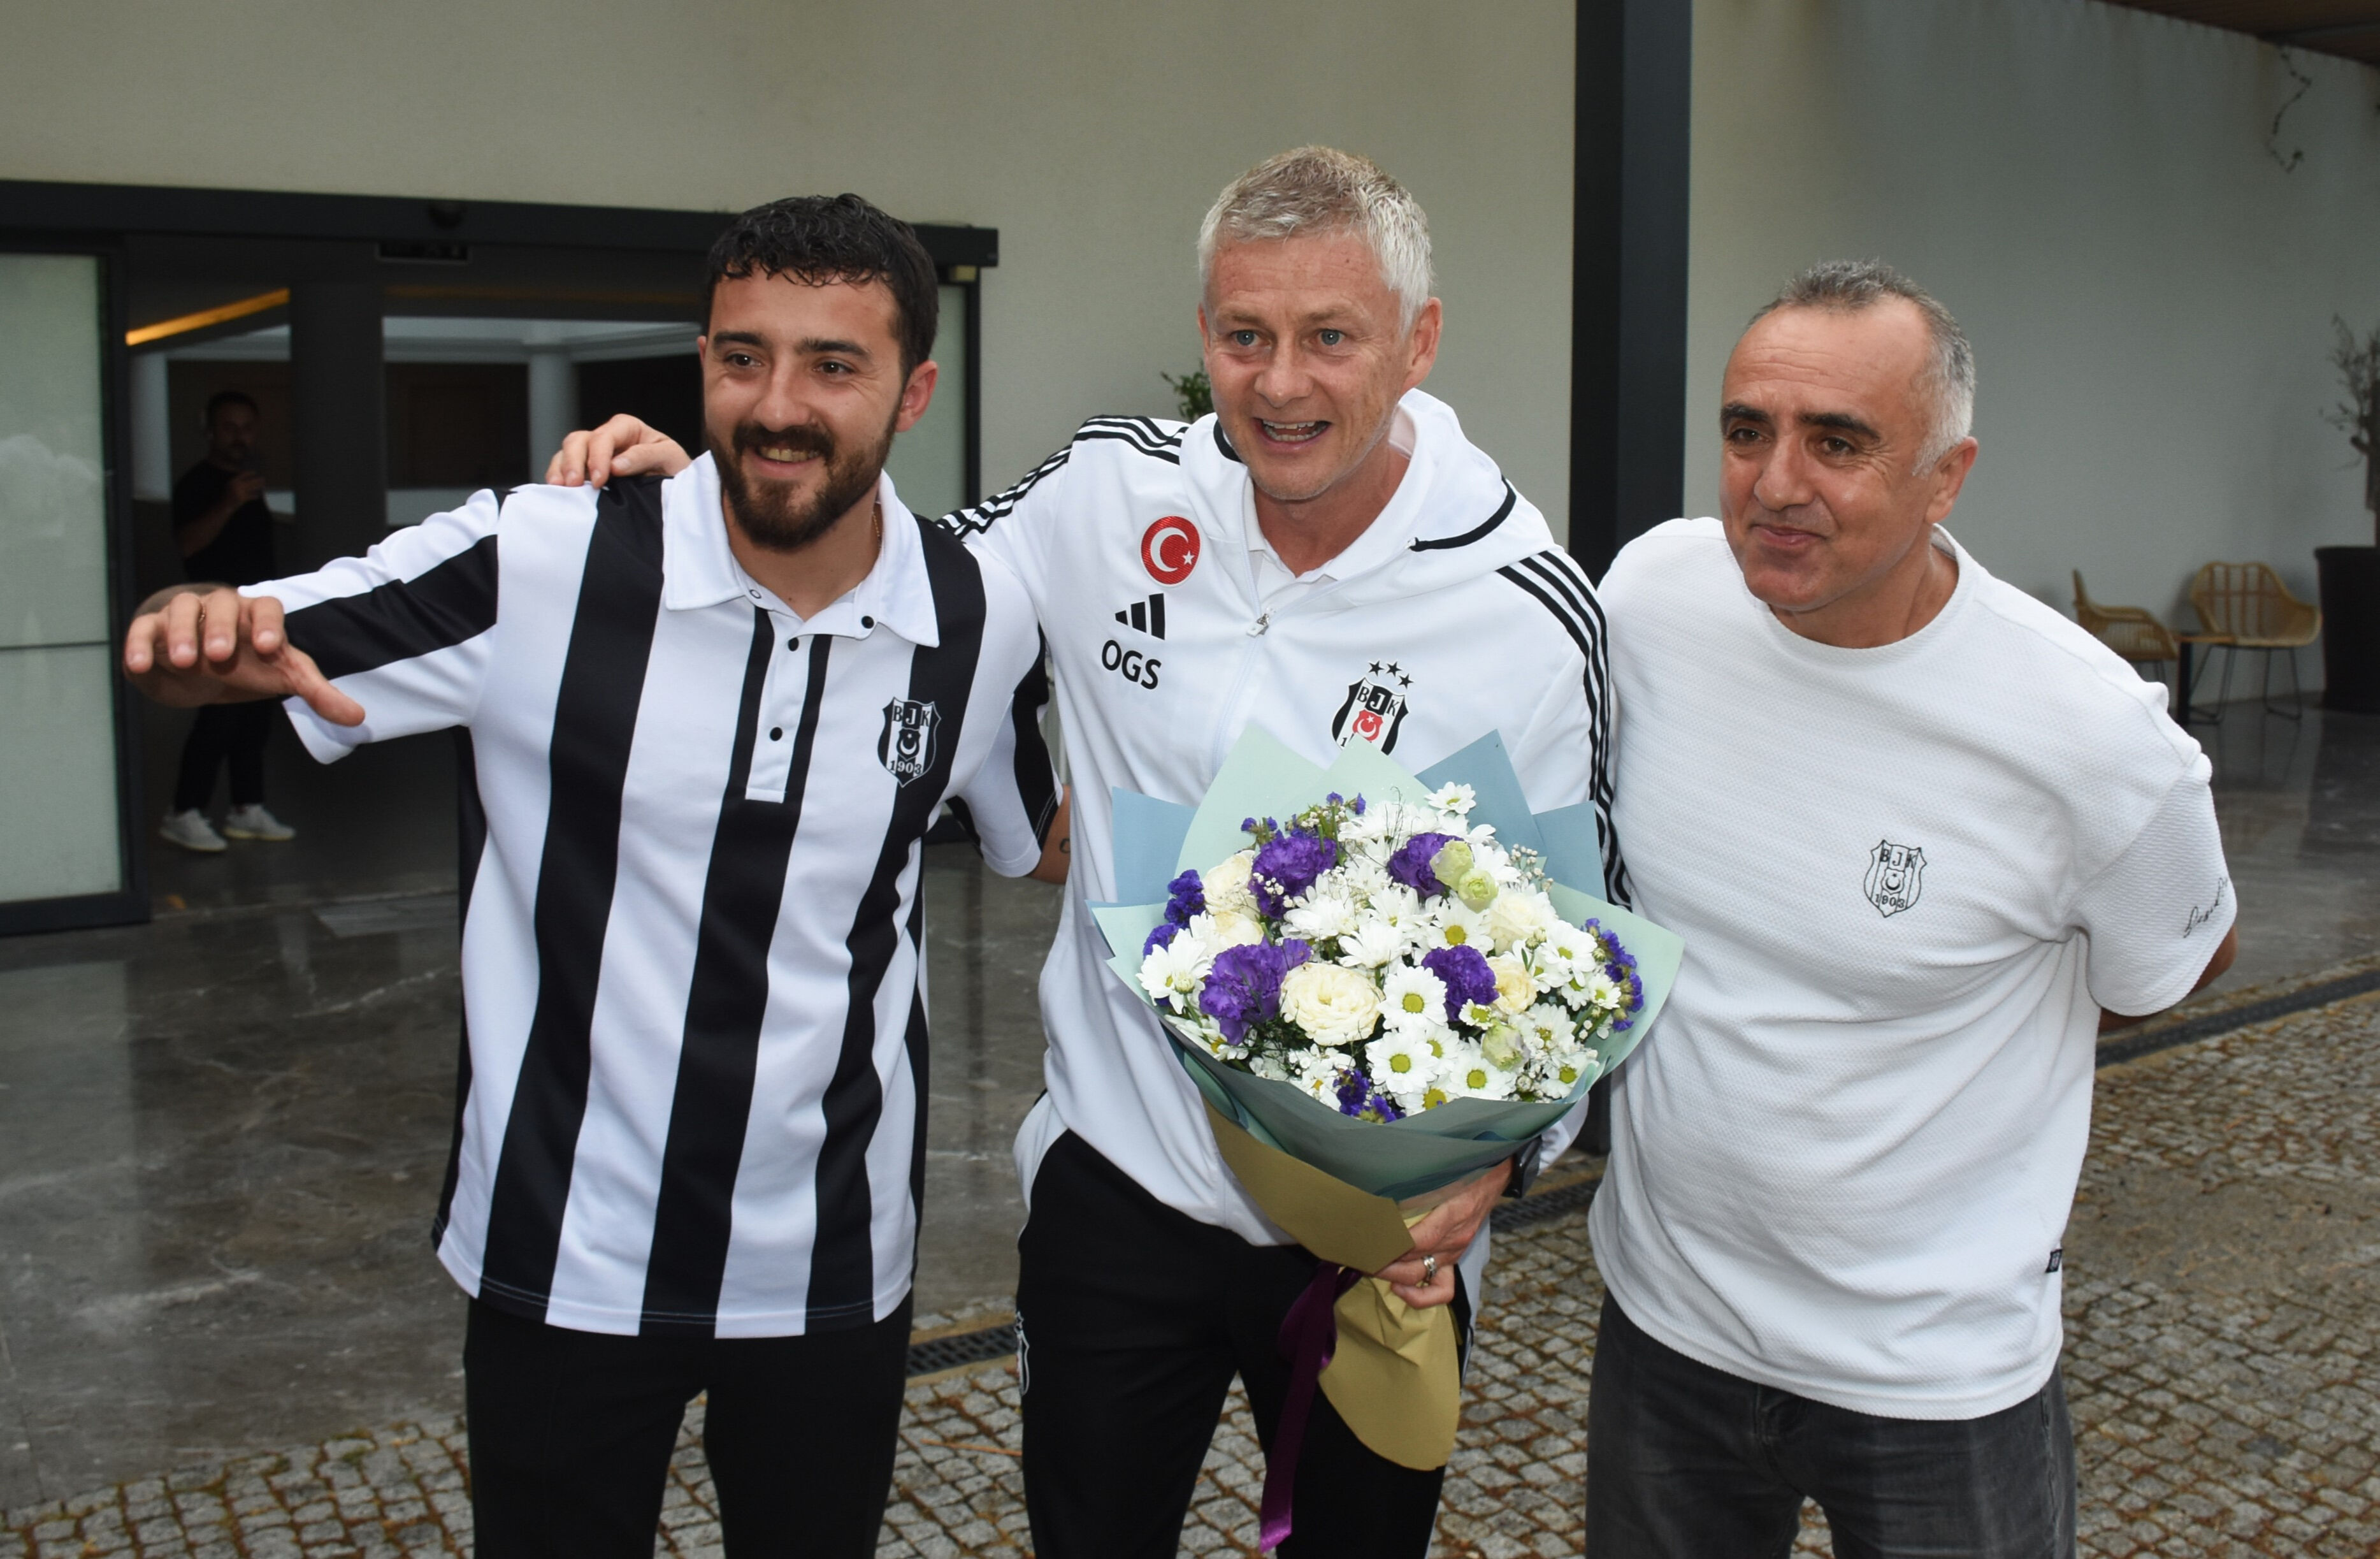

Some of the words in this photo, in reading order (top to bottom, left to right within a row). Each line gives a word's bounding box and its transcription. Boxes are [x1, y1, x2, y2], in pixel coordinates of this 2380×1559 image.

[1102, 639, 1162, 690] OGS
[1357, 686, 1399, 717] BJK
[892, 705, 930, 727] BJK
[890, 760, 922, 774] 1903
[1880, 848, 1917, 869] BJK
[1875, 894, 1905, 908] 1903
